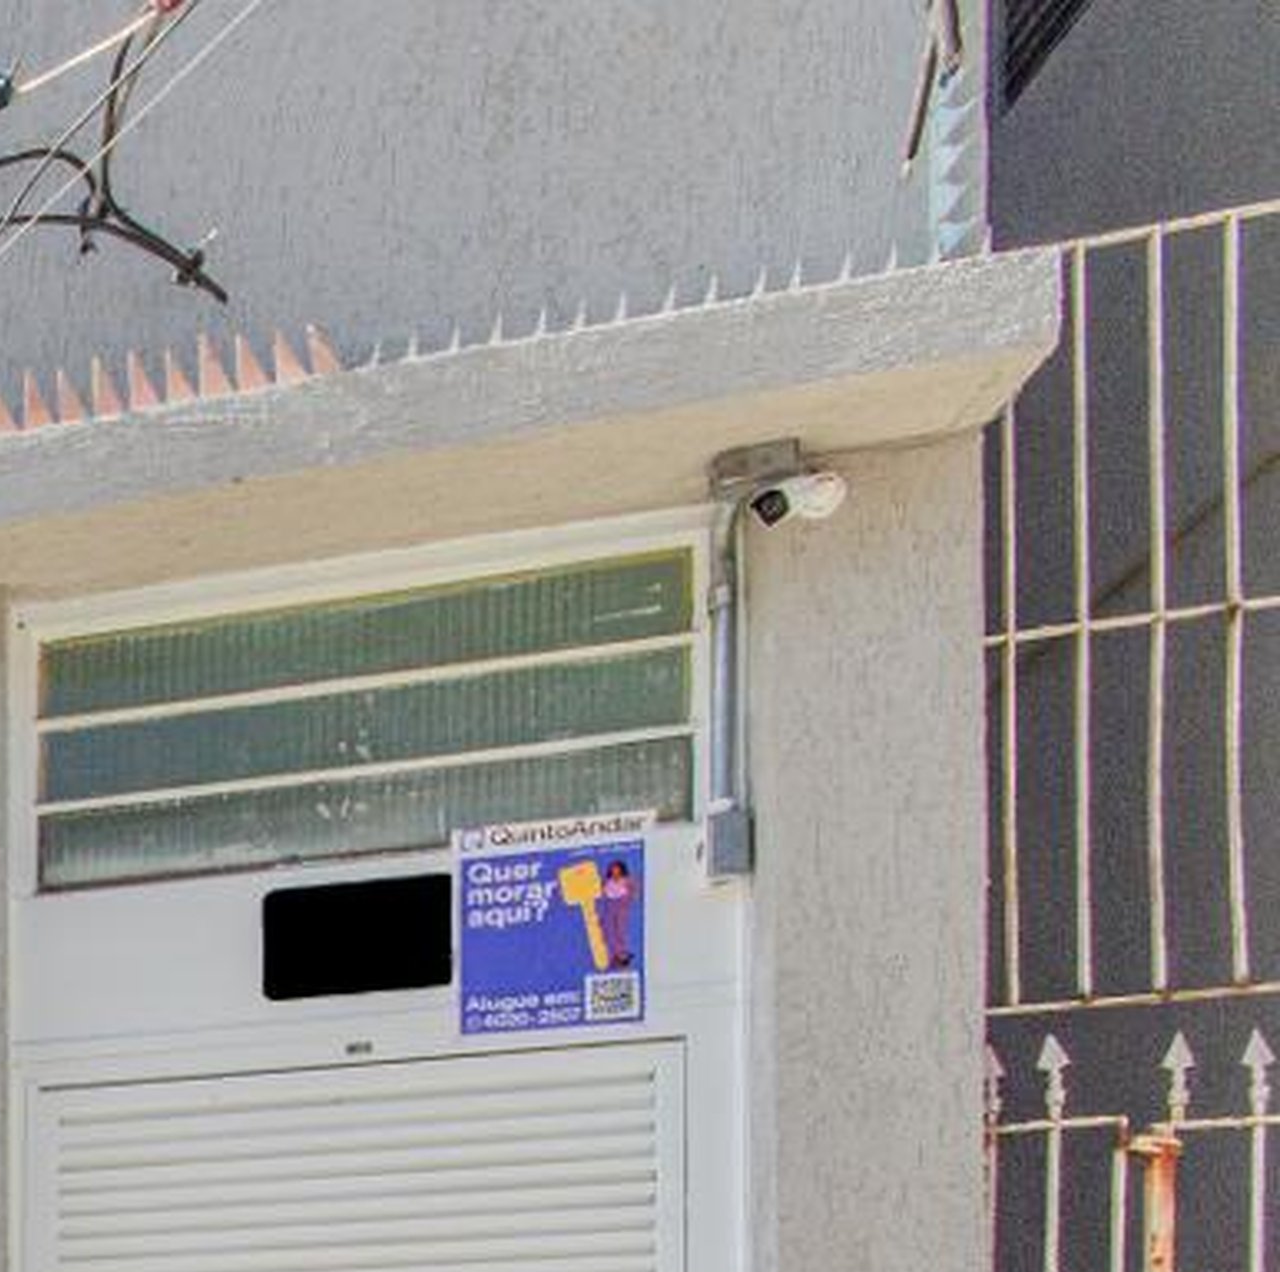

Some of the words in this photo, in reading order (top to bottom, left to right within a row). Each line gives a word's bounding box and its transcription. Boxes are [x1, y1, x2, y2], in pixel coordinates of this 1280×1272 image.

[490, 816, 647, 846] QuintoAndar
[467, 862, 542, 884] Quer
[466, 882, 557, 907] morar
[467, 901, 549, 929] aqui?
[466, 992, 539, 1013] Alugue
